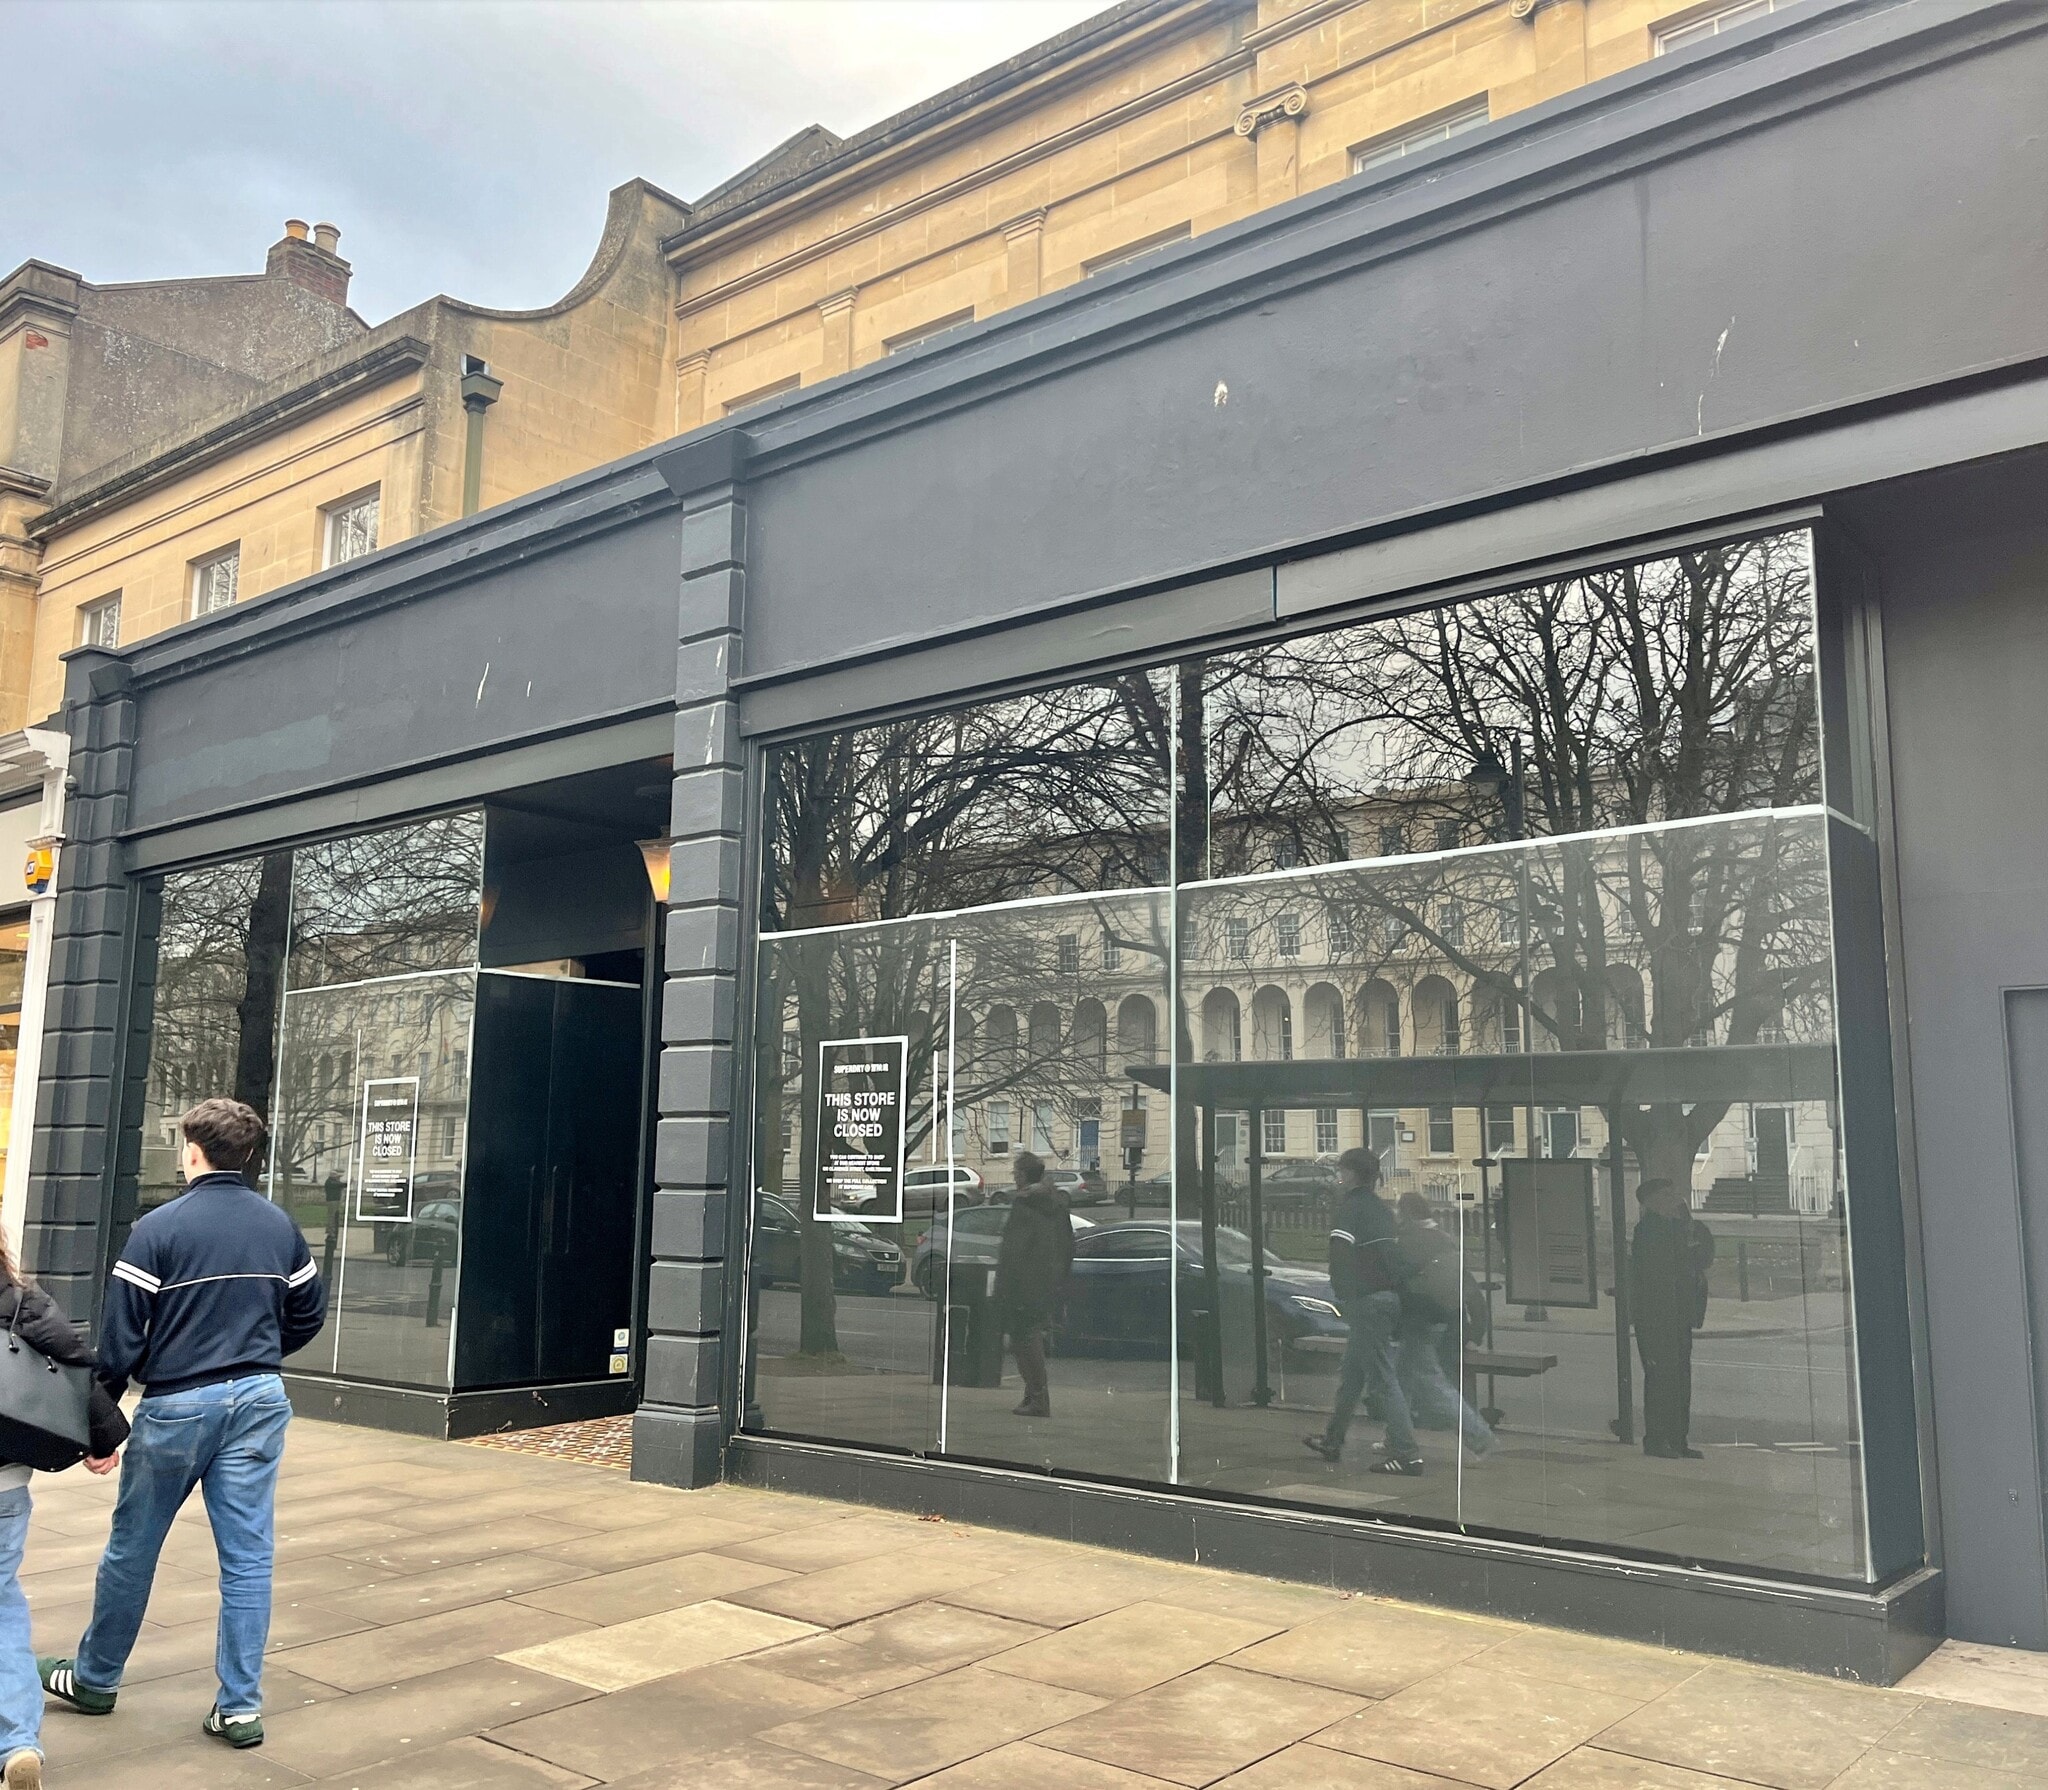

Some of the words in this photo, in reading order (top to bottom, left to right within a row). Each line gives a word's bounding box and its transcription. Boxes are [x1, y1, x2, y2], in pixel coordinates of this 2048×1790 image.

[825, 1093, 851, 1106] THIS
[854, 1092, 895, 1106] STORE
[837, 1108, 848, 1121] IS
[851, 1108, 881, 1121] NOW
[368, 1121, 384, 1132] THIS
[385, 1121, 411, 1131] STORE
[834, 1123, 883, 1137] CLOSED
[375, 1133, 382, 1144] IS
[383, 1133, 401, 1144] NOW
[372, 1145, 402, 1157] CLOSED
